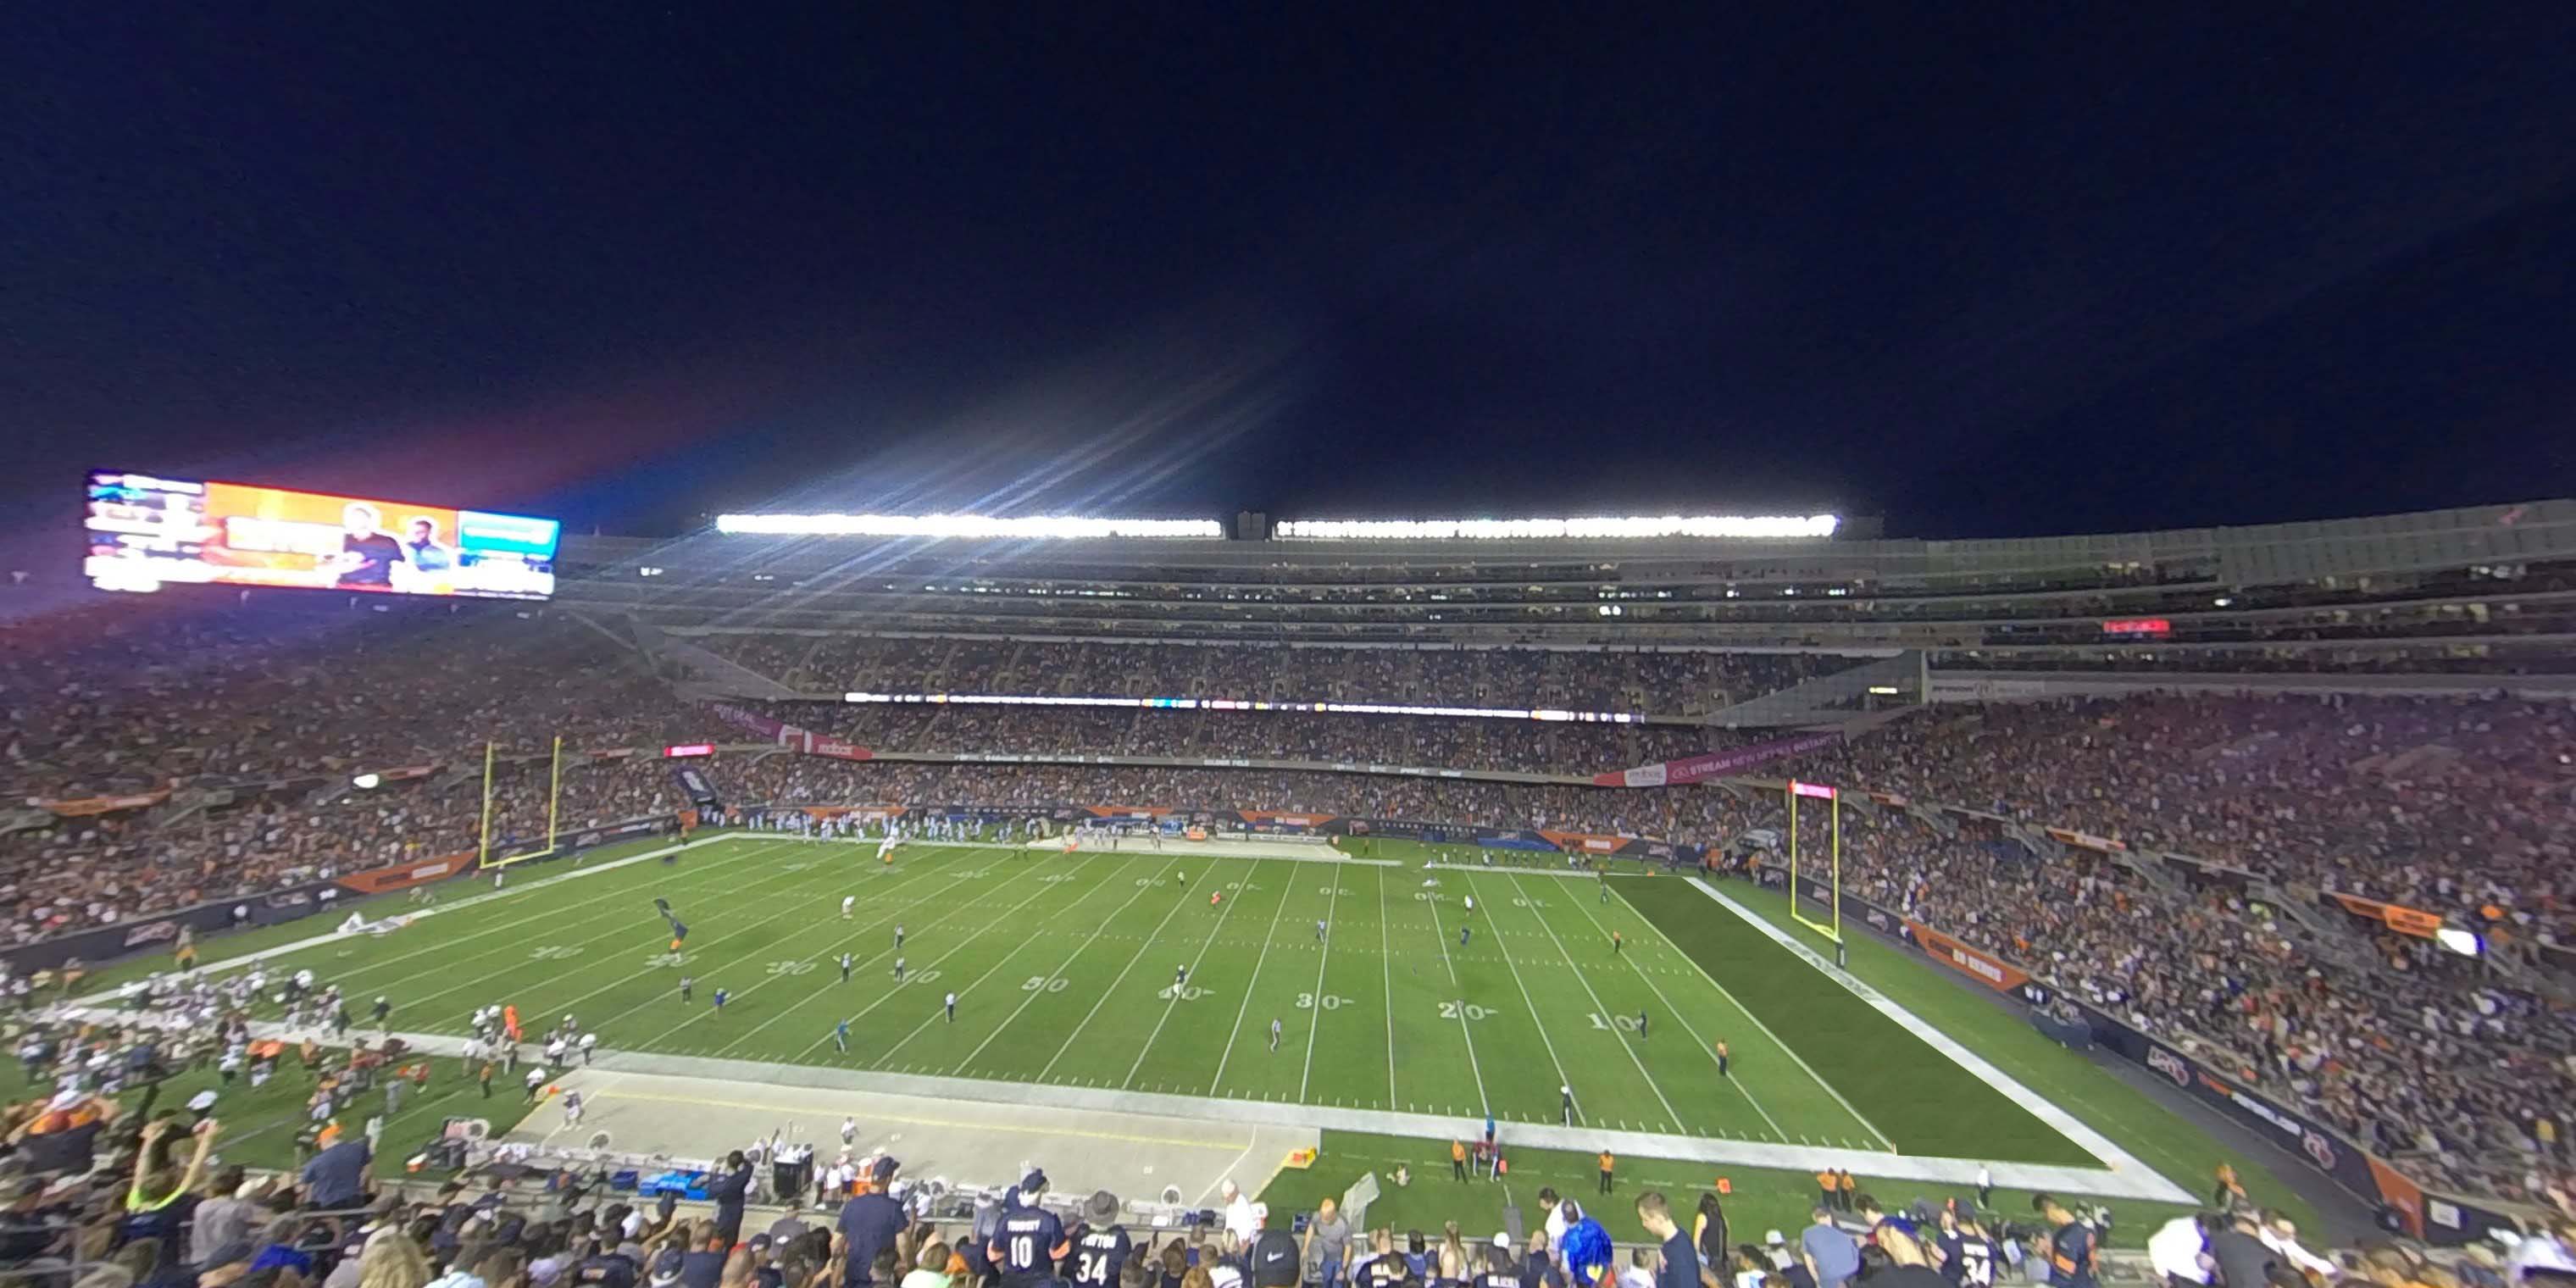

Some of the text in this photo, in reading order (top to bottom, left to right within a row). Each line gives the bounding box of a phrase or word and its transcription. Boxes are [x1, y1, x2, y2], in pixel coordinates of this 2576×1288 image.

[1021, 976, 1069, 993] 50
[1296, 992, 1341, 1010] 30
[1438, 1001, 1486, 1020] 20
[1586, 1013, 1637, 1032] 10
[1011, 1235, 1032, 1269] 10
[1076, 1252, 1108, 1286] 34
